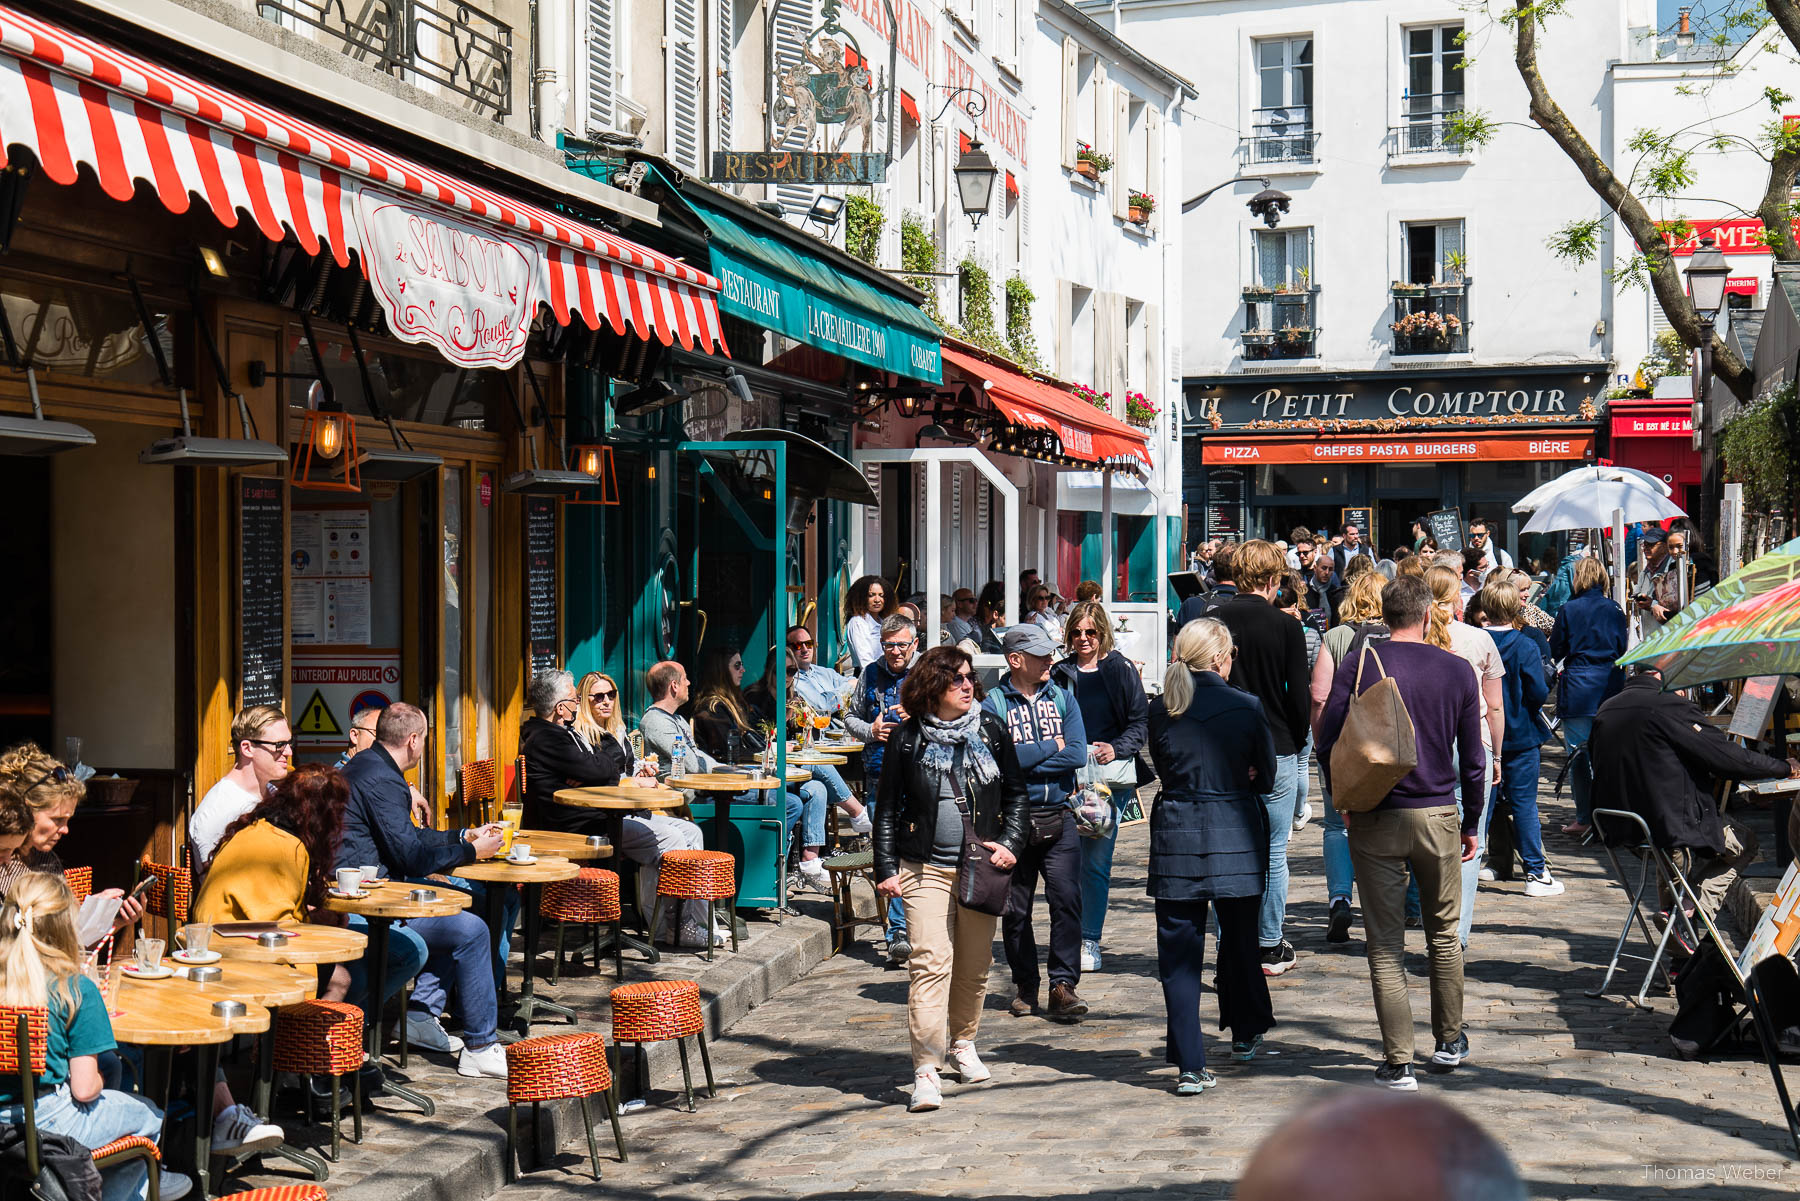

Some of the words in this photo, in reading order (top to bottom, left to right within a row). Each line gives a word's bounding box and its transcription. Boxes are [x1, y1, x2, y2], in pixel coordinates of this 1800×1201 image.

[724, 153, 875, 180] RESTAURANT
[408, 214, 504, 298] SABOT
[721, 266, 780, 319] RESTAURANT
[448, 304, 514, 353] Rouge
[872, 329, 886, 360] 1900
[911, 343, 938, 373] CABARET
[1251, 387, 1354, 418] PETIT
[1387, 386, 1567, 416] COMPTOIR
[1224, 447, 1261, 459] PIZZA
[1314, 445, 1364, 457] CREPES
[1369, 444, 1409, 456] PASTA
[1415, 443, 1477, 455] BURGERS
[1529, 440, 1570, 454] BIÈRE
[298, 669, 336, 681] INTERDIT
[337, 669, 349, 681] AU
[350, 669, 380, 681] PUBLIC
[1008, 723, 1034, 742] AR
